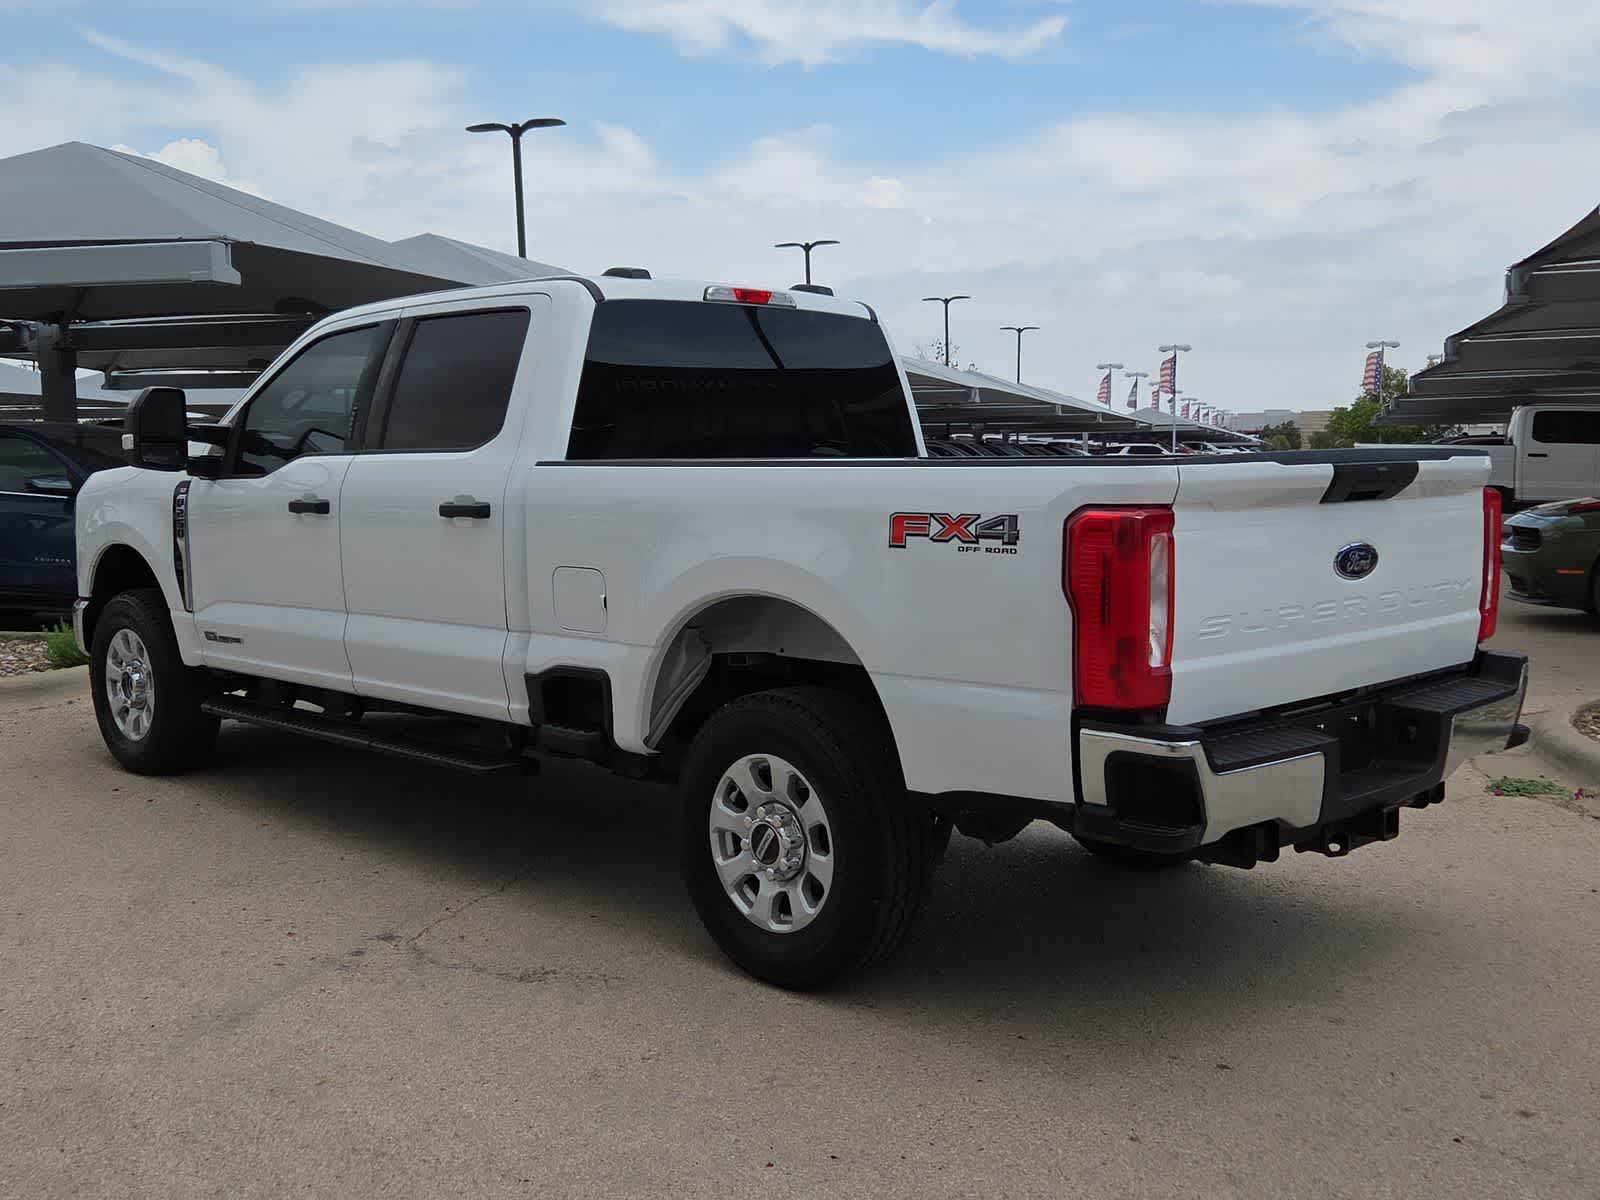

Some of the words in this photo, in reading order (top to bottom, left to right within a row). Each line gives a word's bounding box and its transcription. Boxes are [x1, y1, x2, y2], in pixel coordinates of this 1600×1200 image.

[889, 512, 1020, 549] FX4
[957, 545, 982, 553] OFF
[985, 546, 1018, 555] ROAD
[1198, 594, 1368, 640] SUPER
